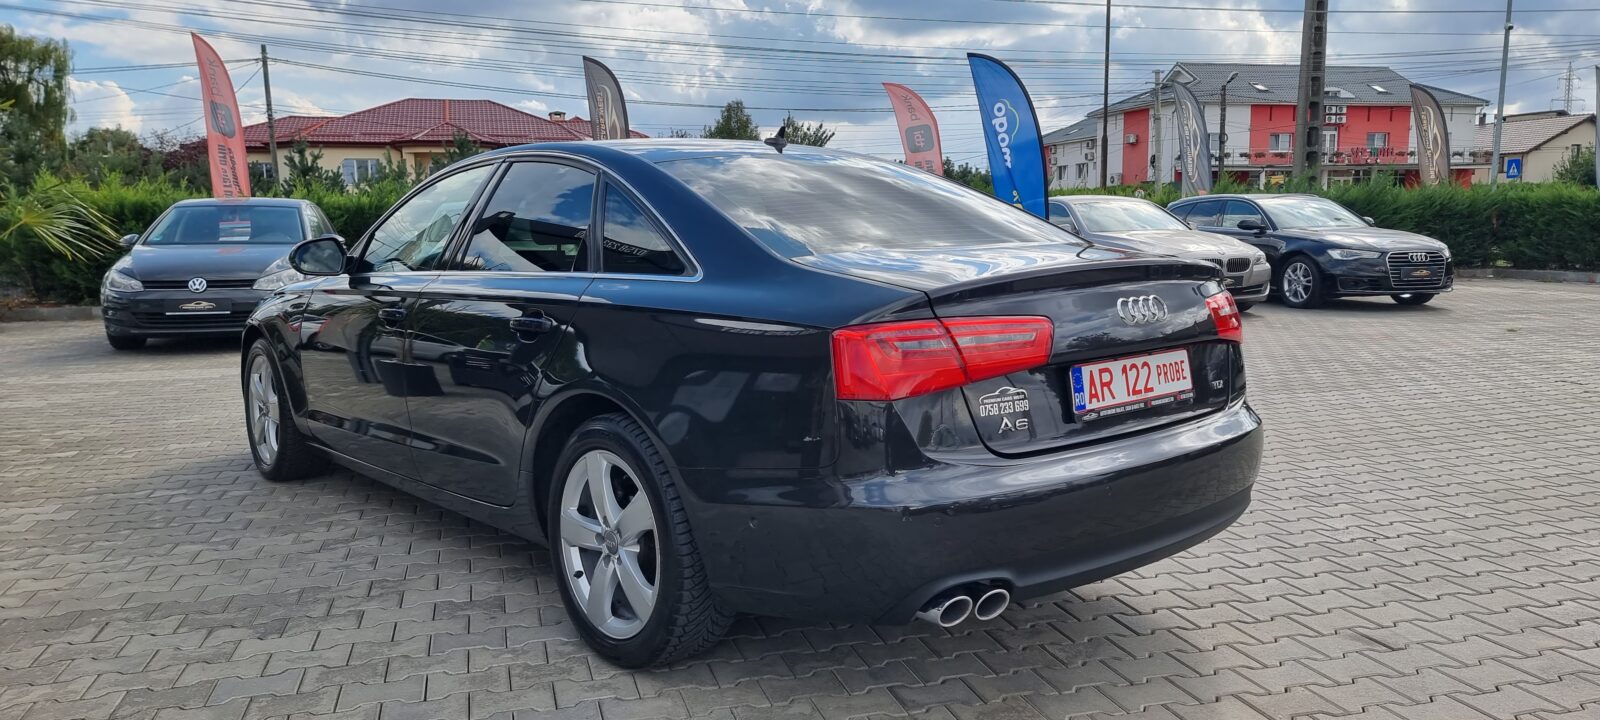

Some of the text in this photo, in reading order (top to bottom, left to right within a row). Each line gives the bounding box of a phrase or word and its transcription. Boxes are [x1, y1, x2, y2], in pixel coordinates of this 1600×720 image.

[1088, 360, 1187, 404] AR 122 PROBE
[1074, 392, 1085, 406] RO
[980, 400, 1029, 417] 0758 233 699
[998, 416, 1029, 433] A6
